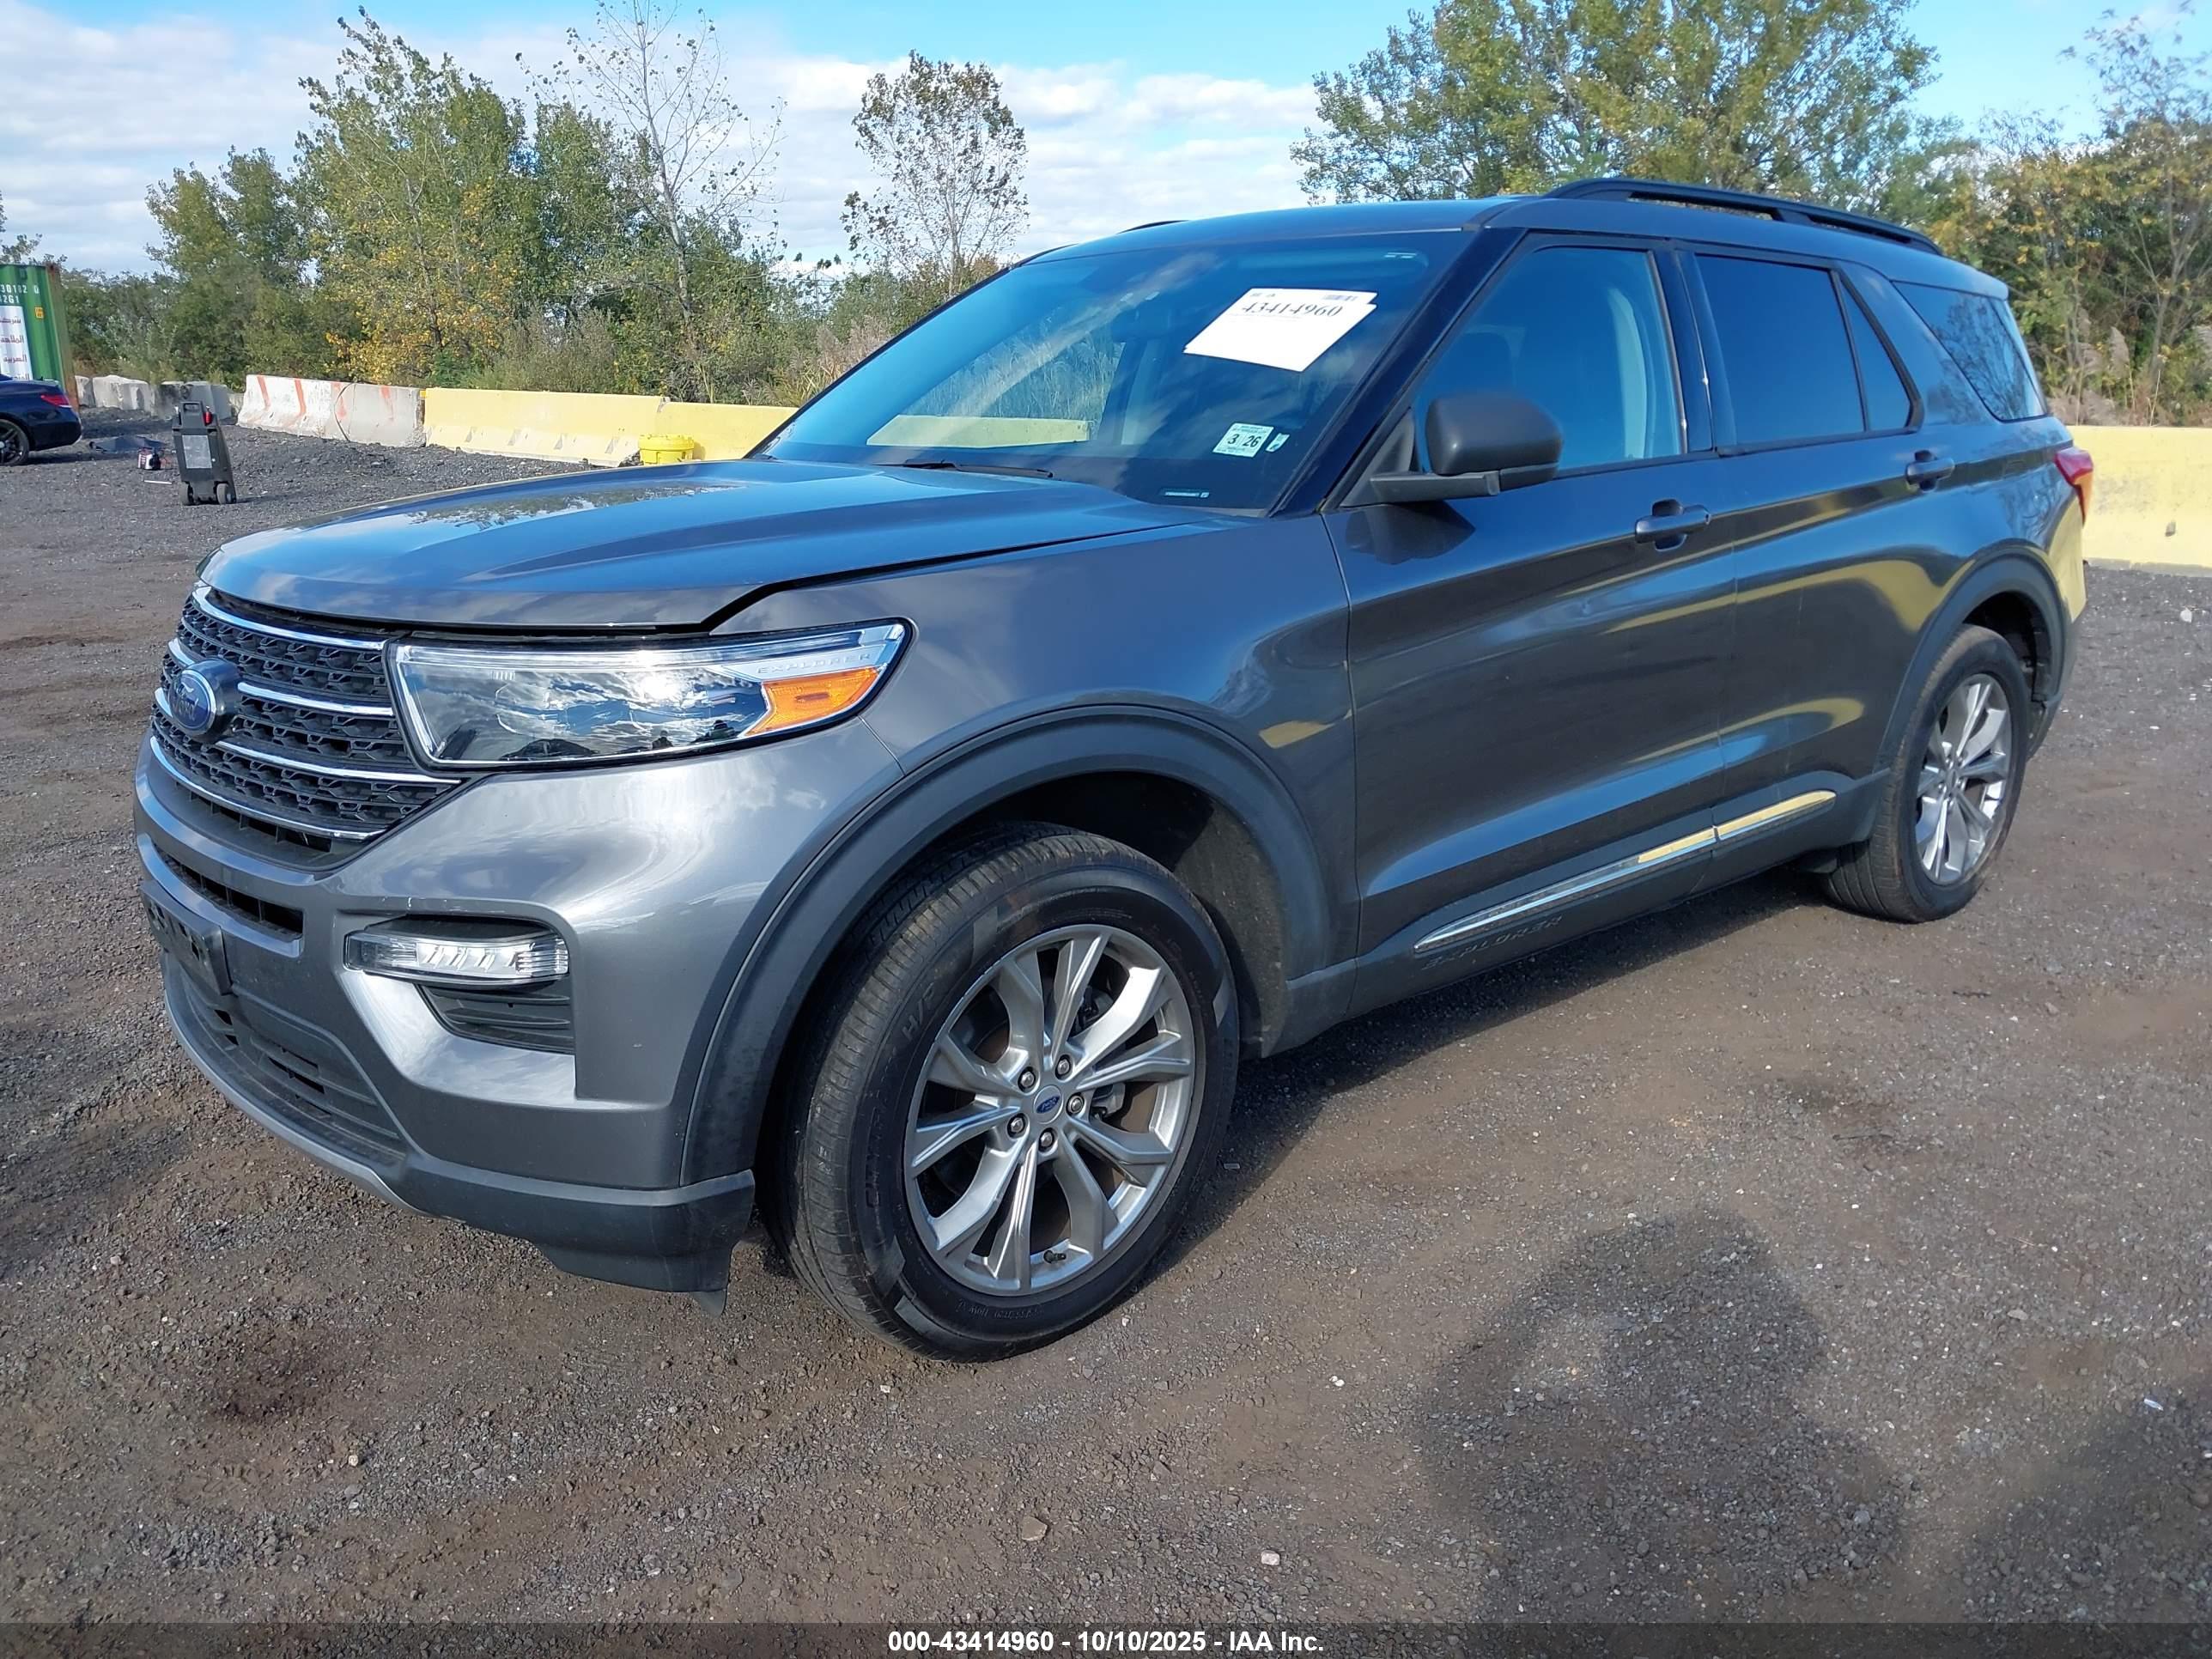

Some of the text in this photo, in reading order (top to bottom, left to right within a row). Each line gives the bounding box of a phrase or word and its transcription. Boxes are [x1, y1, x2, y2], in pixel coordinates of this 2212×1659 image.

[1242, 302, 1343, 317] 43414960
[1228, 434, 1262, 448] 3 26
